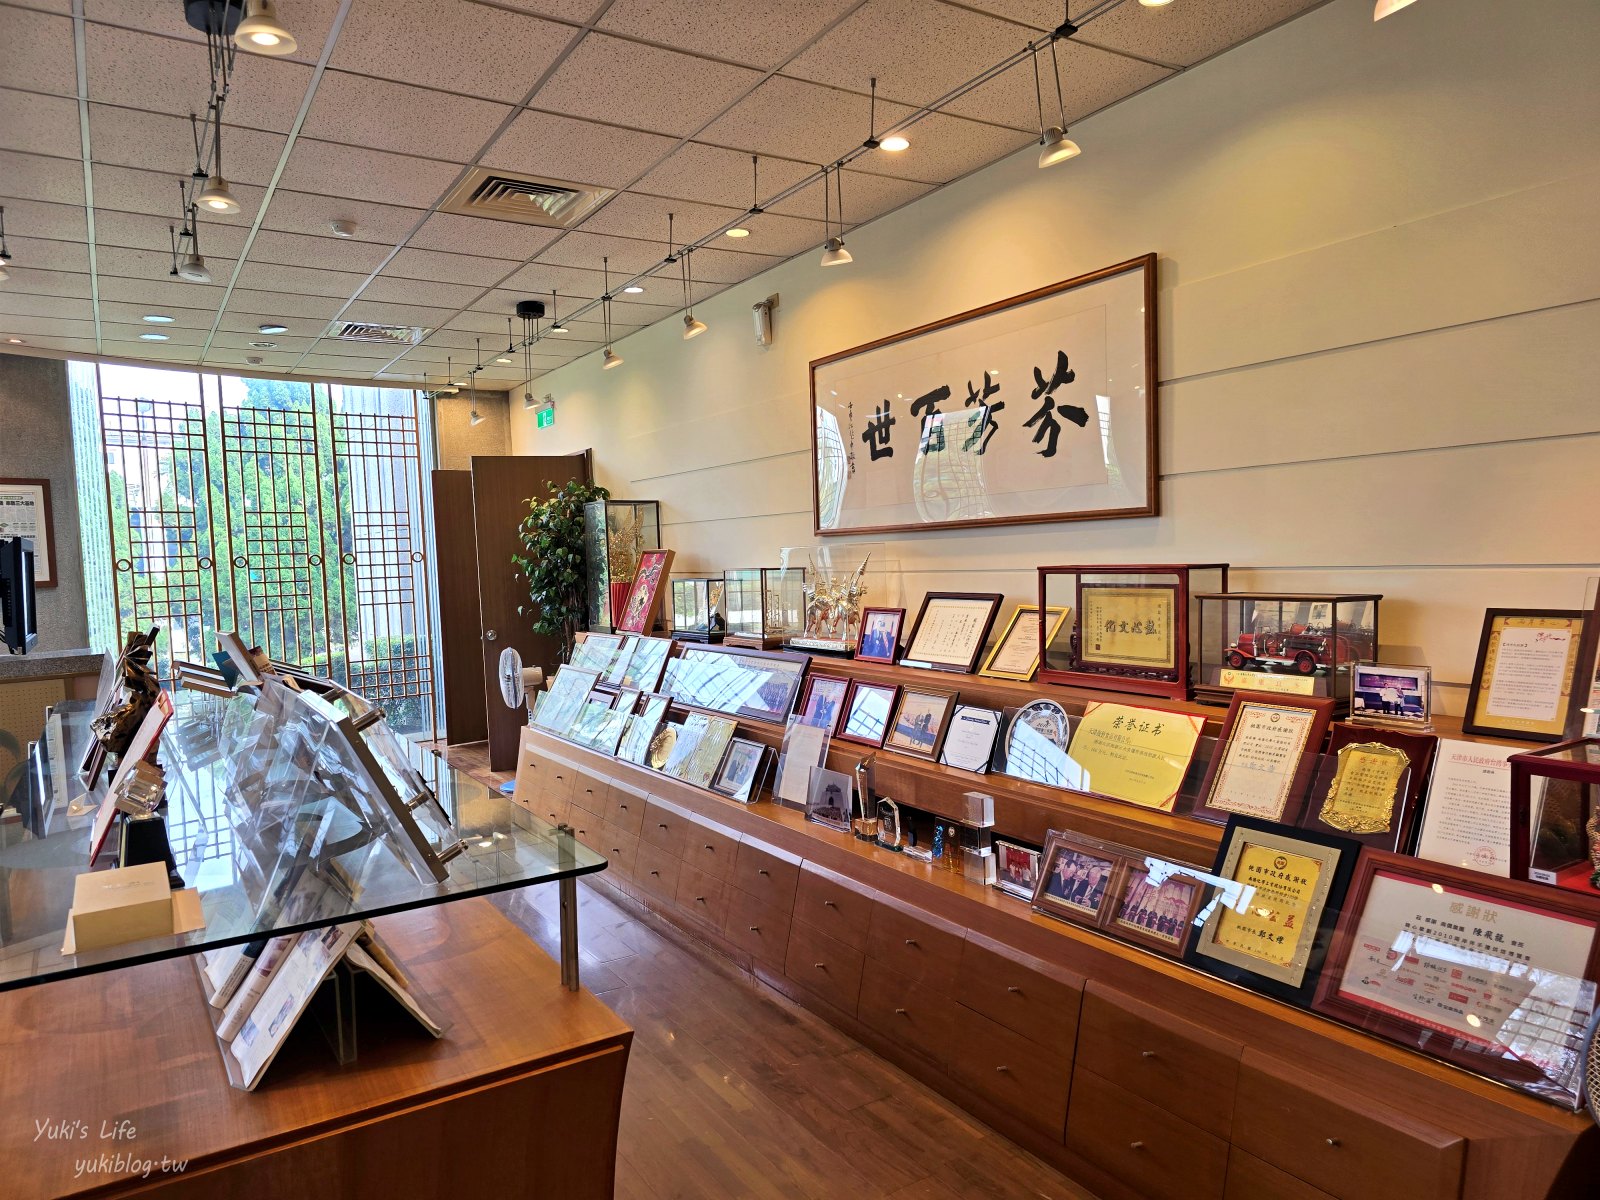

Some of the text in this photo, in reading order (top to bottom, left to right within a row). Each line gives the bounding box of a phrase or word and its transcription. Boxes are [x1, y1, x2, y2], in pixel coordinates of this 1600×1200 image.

[1112, 715, 1165, 736] 荣誉证书
[1451, 754, 1511, 768] 天津市人民政府台湾事
[1248, 864, 1308, 886] 桃園市政府感謝狀
[1449, 902, 1498, 924] 感謝狀
